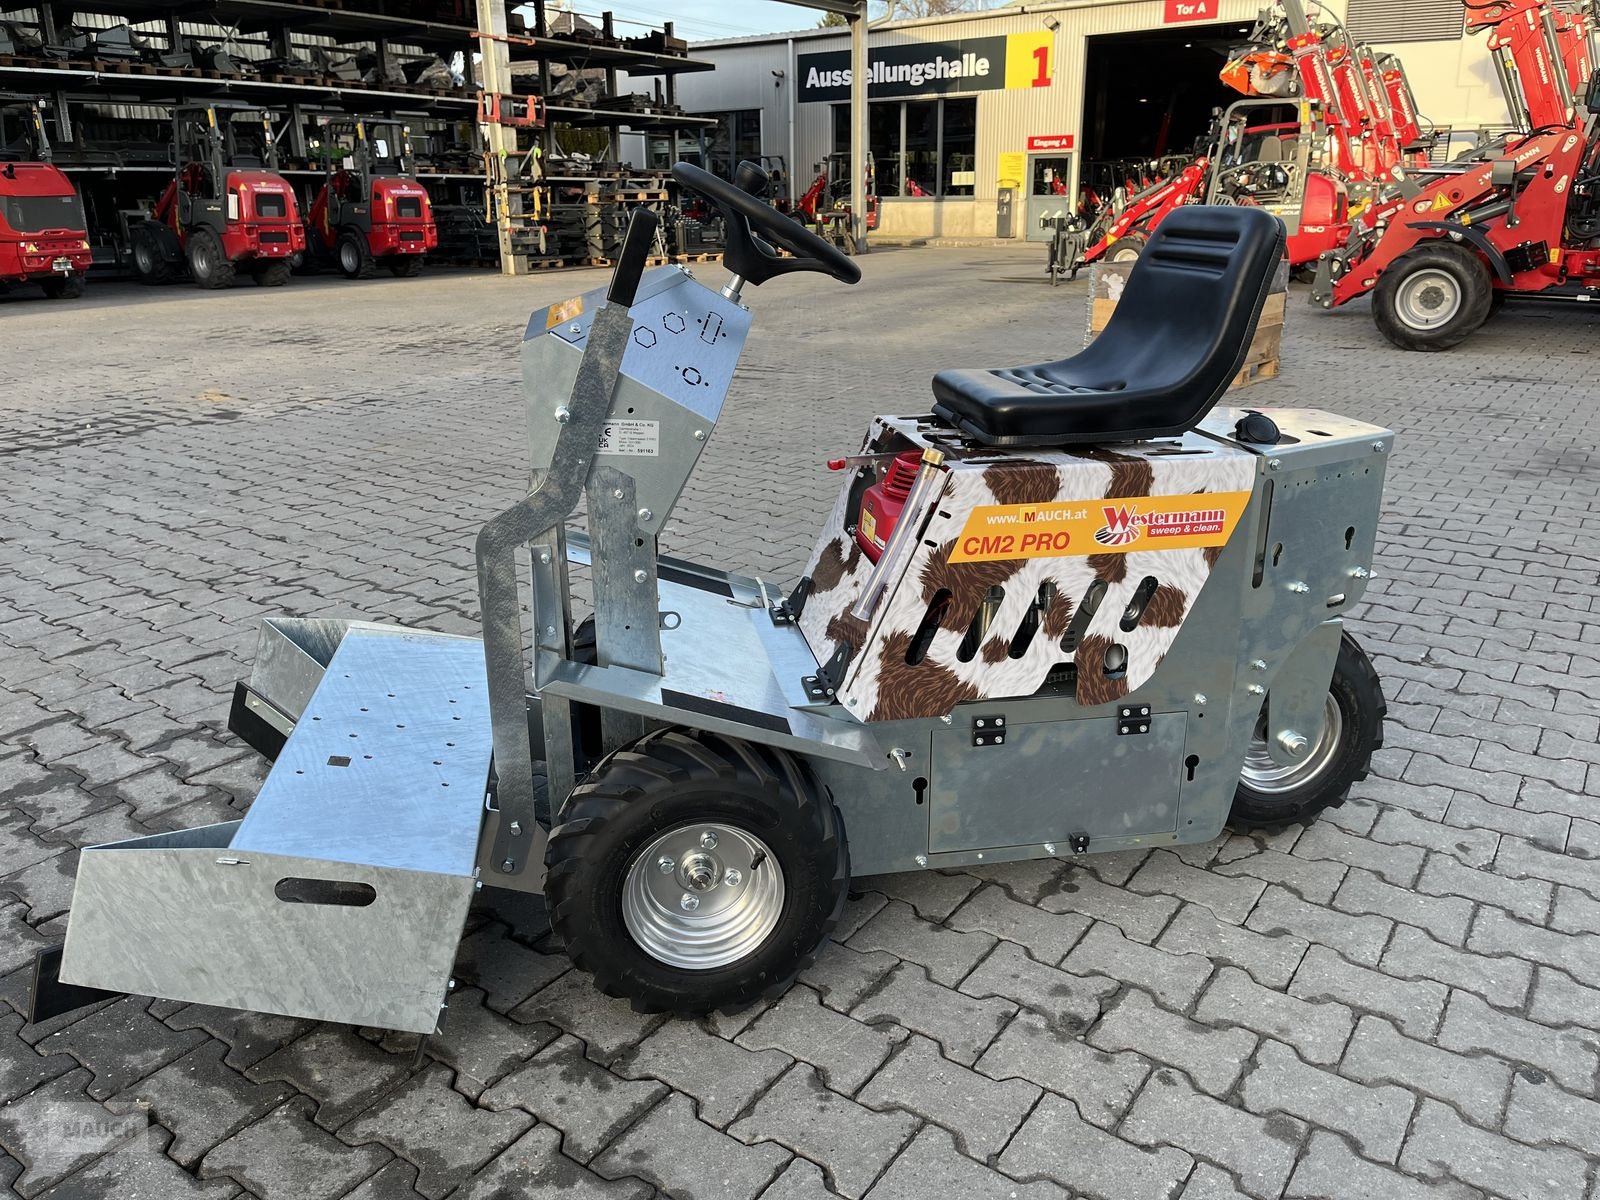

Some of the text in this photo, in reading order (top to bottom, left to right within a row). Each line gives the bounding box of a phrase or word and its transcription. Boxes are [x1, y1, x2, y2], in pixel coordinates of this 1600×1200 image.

[1176, 2, 1206, 15] Tor A
[806, 46, 1052, 89] Aussellungshalle 1
[1312, 54, 1332, 104] WEIDEMANN
[1033, 139, 1060, 148] Eingang
[987, 508, 1088, 525] www.MAUCH.at
[1102, 504, 1226, 532] Westermann
[1150, 523, 1221, 536] sweep & clean.
[963, 531, 1071, 556] CM2 PRO
